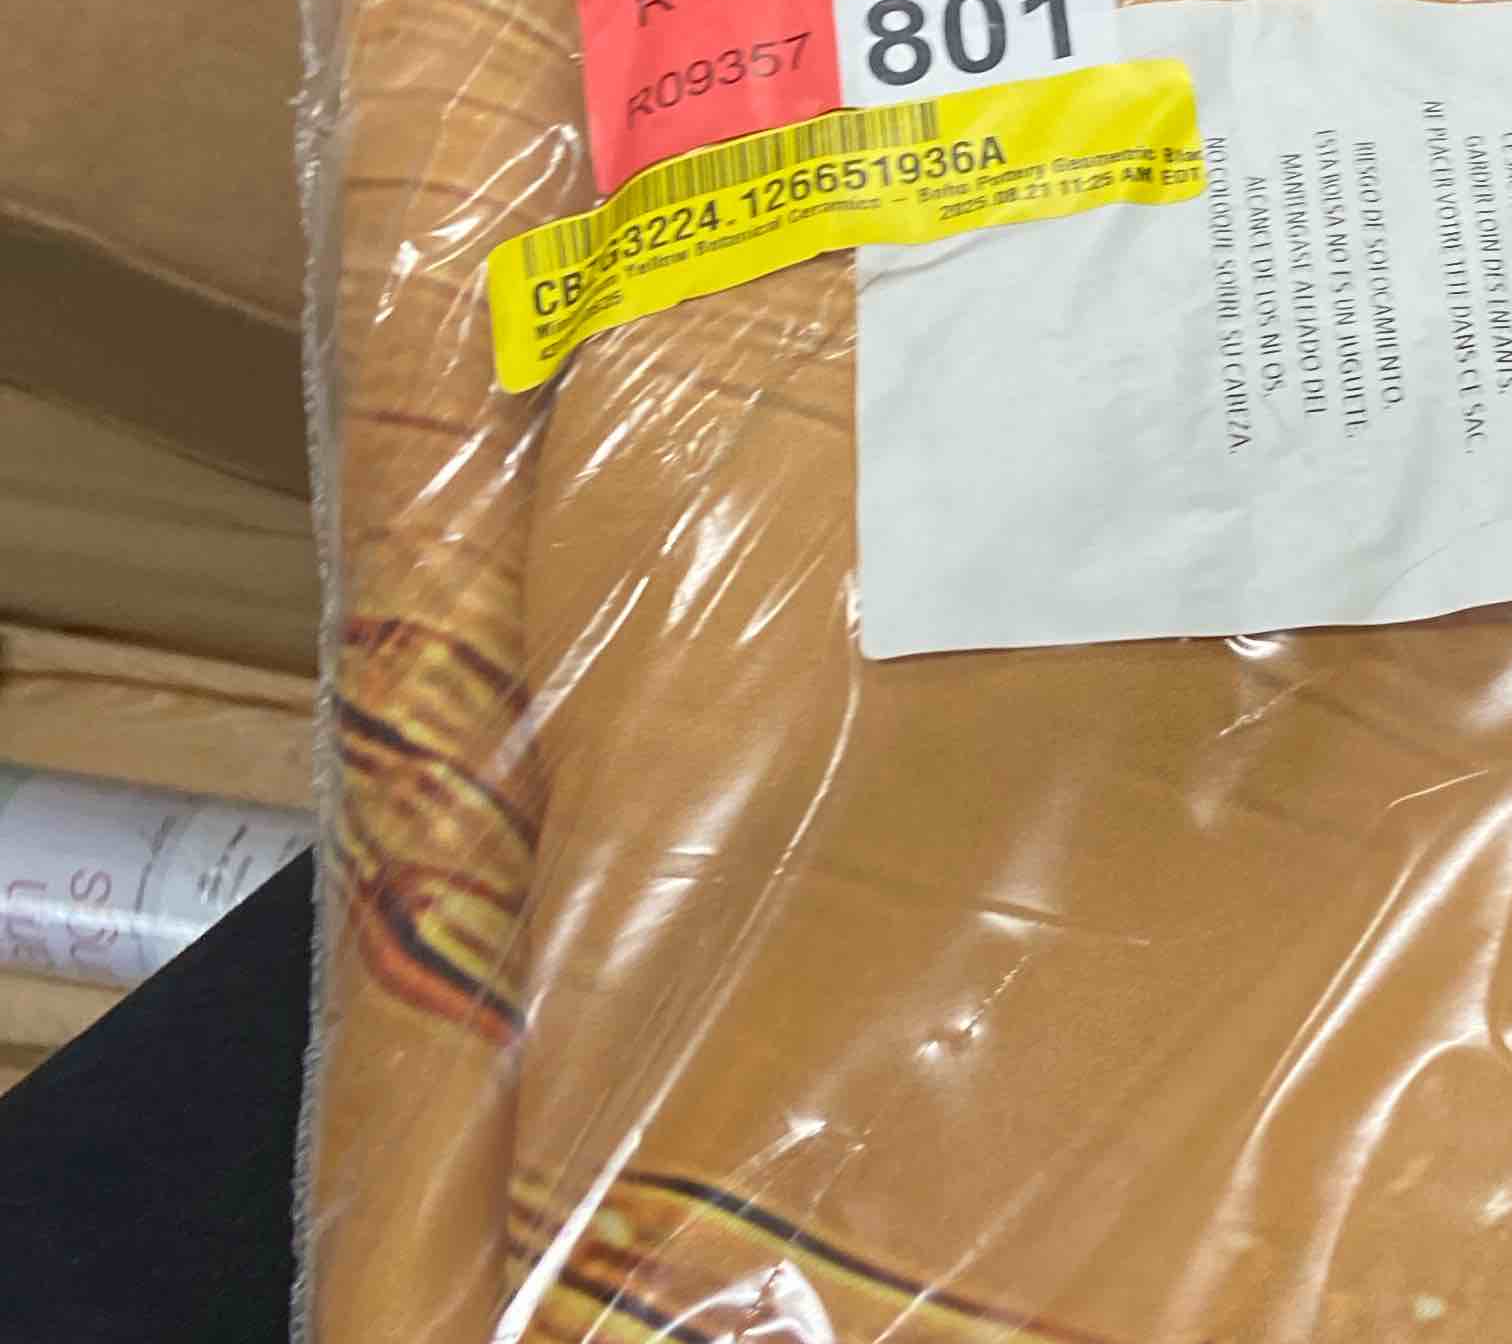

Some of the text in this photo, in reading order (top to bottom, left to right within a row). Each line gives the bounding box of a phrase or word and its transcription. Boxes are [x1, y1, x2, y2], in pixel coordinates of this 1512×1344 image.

[627, 31, 812, 125] R09357
[1203, 137, 1230, 163] NO
[1423, 128, 1455, 189] PLACER
[1120, 166, 1153, 185] AM
[1351, 141, 1383, 203] RIESGO
[1463, 136, 1495, 204] GARDER
[1205, 167, 1236, 249] COLOQUE
[1318, 174, 1346, 228] BOLSA
[1360, 209, 1385, 231] DE
[1434, 193, 1463, 250] VOTRE
[1473, 209, 1501, 252] LOIN
[1324, 233, 1350, 263] NO
[1250, 258, 1273, 280] DE
[1329, 271, 1353, 293] ES
[1480, 259, 1506, 292] DES
[1254, 290, 1277, 327] LOS
[1332, 298, 1356, 326] UN
[1218, 330, 1243, 356] SU
[1447, 306, 1476, 363] DANS
[1300, 378, 1327, 415] DEL
[1458, 369, 1483, 397] CE
